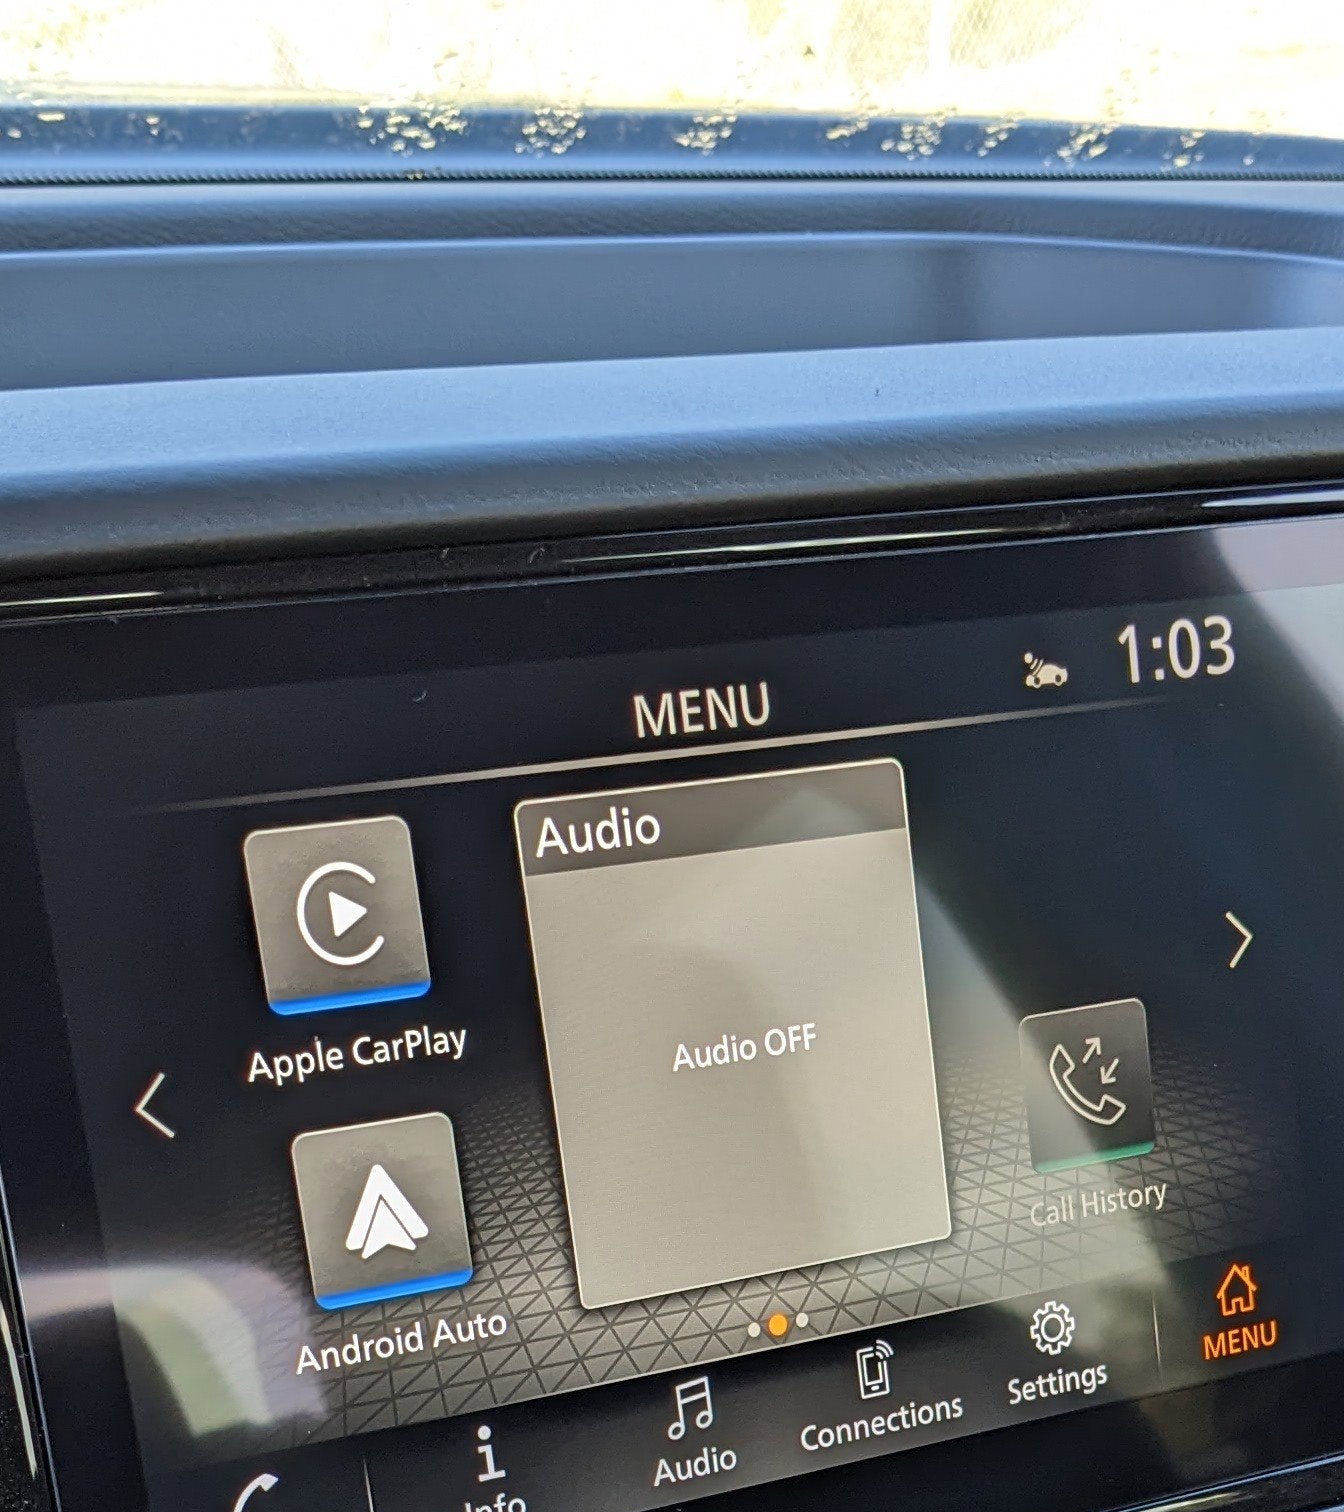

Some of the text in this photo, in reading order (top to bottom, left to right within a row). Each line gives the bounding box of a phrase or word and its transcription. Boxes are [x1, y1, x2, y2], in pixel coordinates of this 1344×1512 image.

[1117, 613, 1237, 685] 1:03
[632, 681, 773, 739] MENU
[535, 806, 661, 859] Audio
[246, 1026, 467, 1088] Apple CarPlay
[671, 1022, 819, 1074] Audio OFF
[1029, 1180, 1168, 1229] Call History
[294, 1312, 509, 1375] Android Auto
[1202, 1320, 1279, 1361] MENU
[1007, 1363, 1109, 1406] Settings
[799, 1395, 964, 1452] Connections
[653, 1446, 738, 1488] Audio
